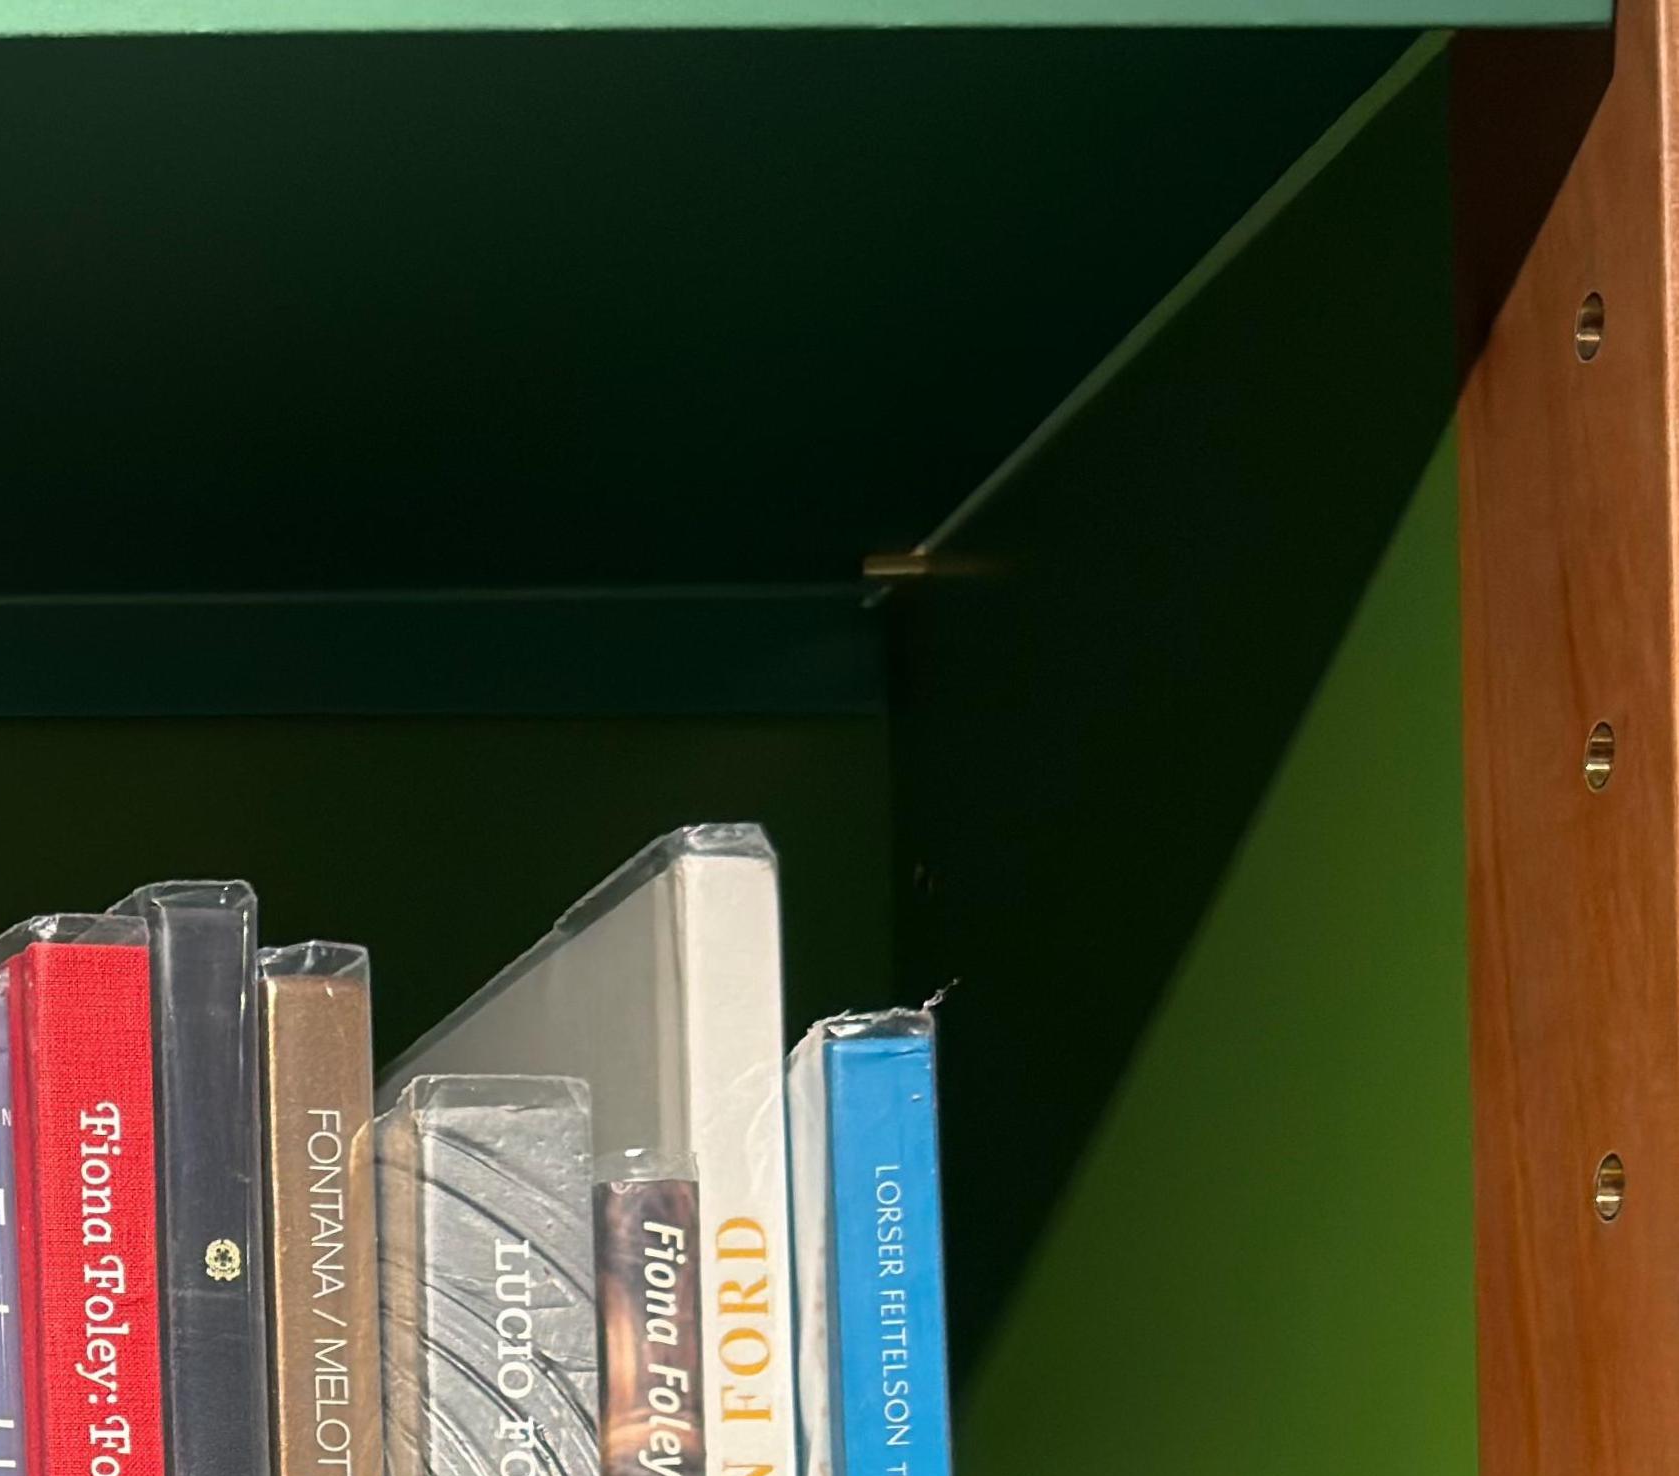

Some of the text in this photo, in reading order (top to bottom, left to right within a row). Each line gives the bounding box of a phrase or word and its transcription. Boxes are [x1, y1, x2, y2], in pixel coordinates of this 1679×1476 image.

[81, 1102, 121, 1245] Fiona
[308, 1110, 344, 1298] FONTANA
[75, 1255, 129, 1404] Foley:
[644, 1222, 686, 1345] Fiona
[717, 1218, 772, 1421] FORD
[875, 1165, 912, 1448] LORSER FEITELSON
